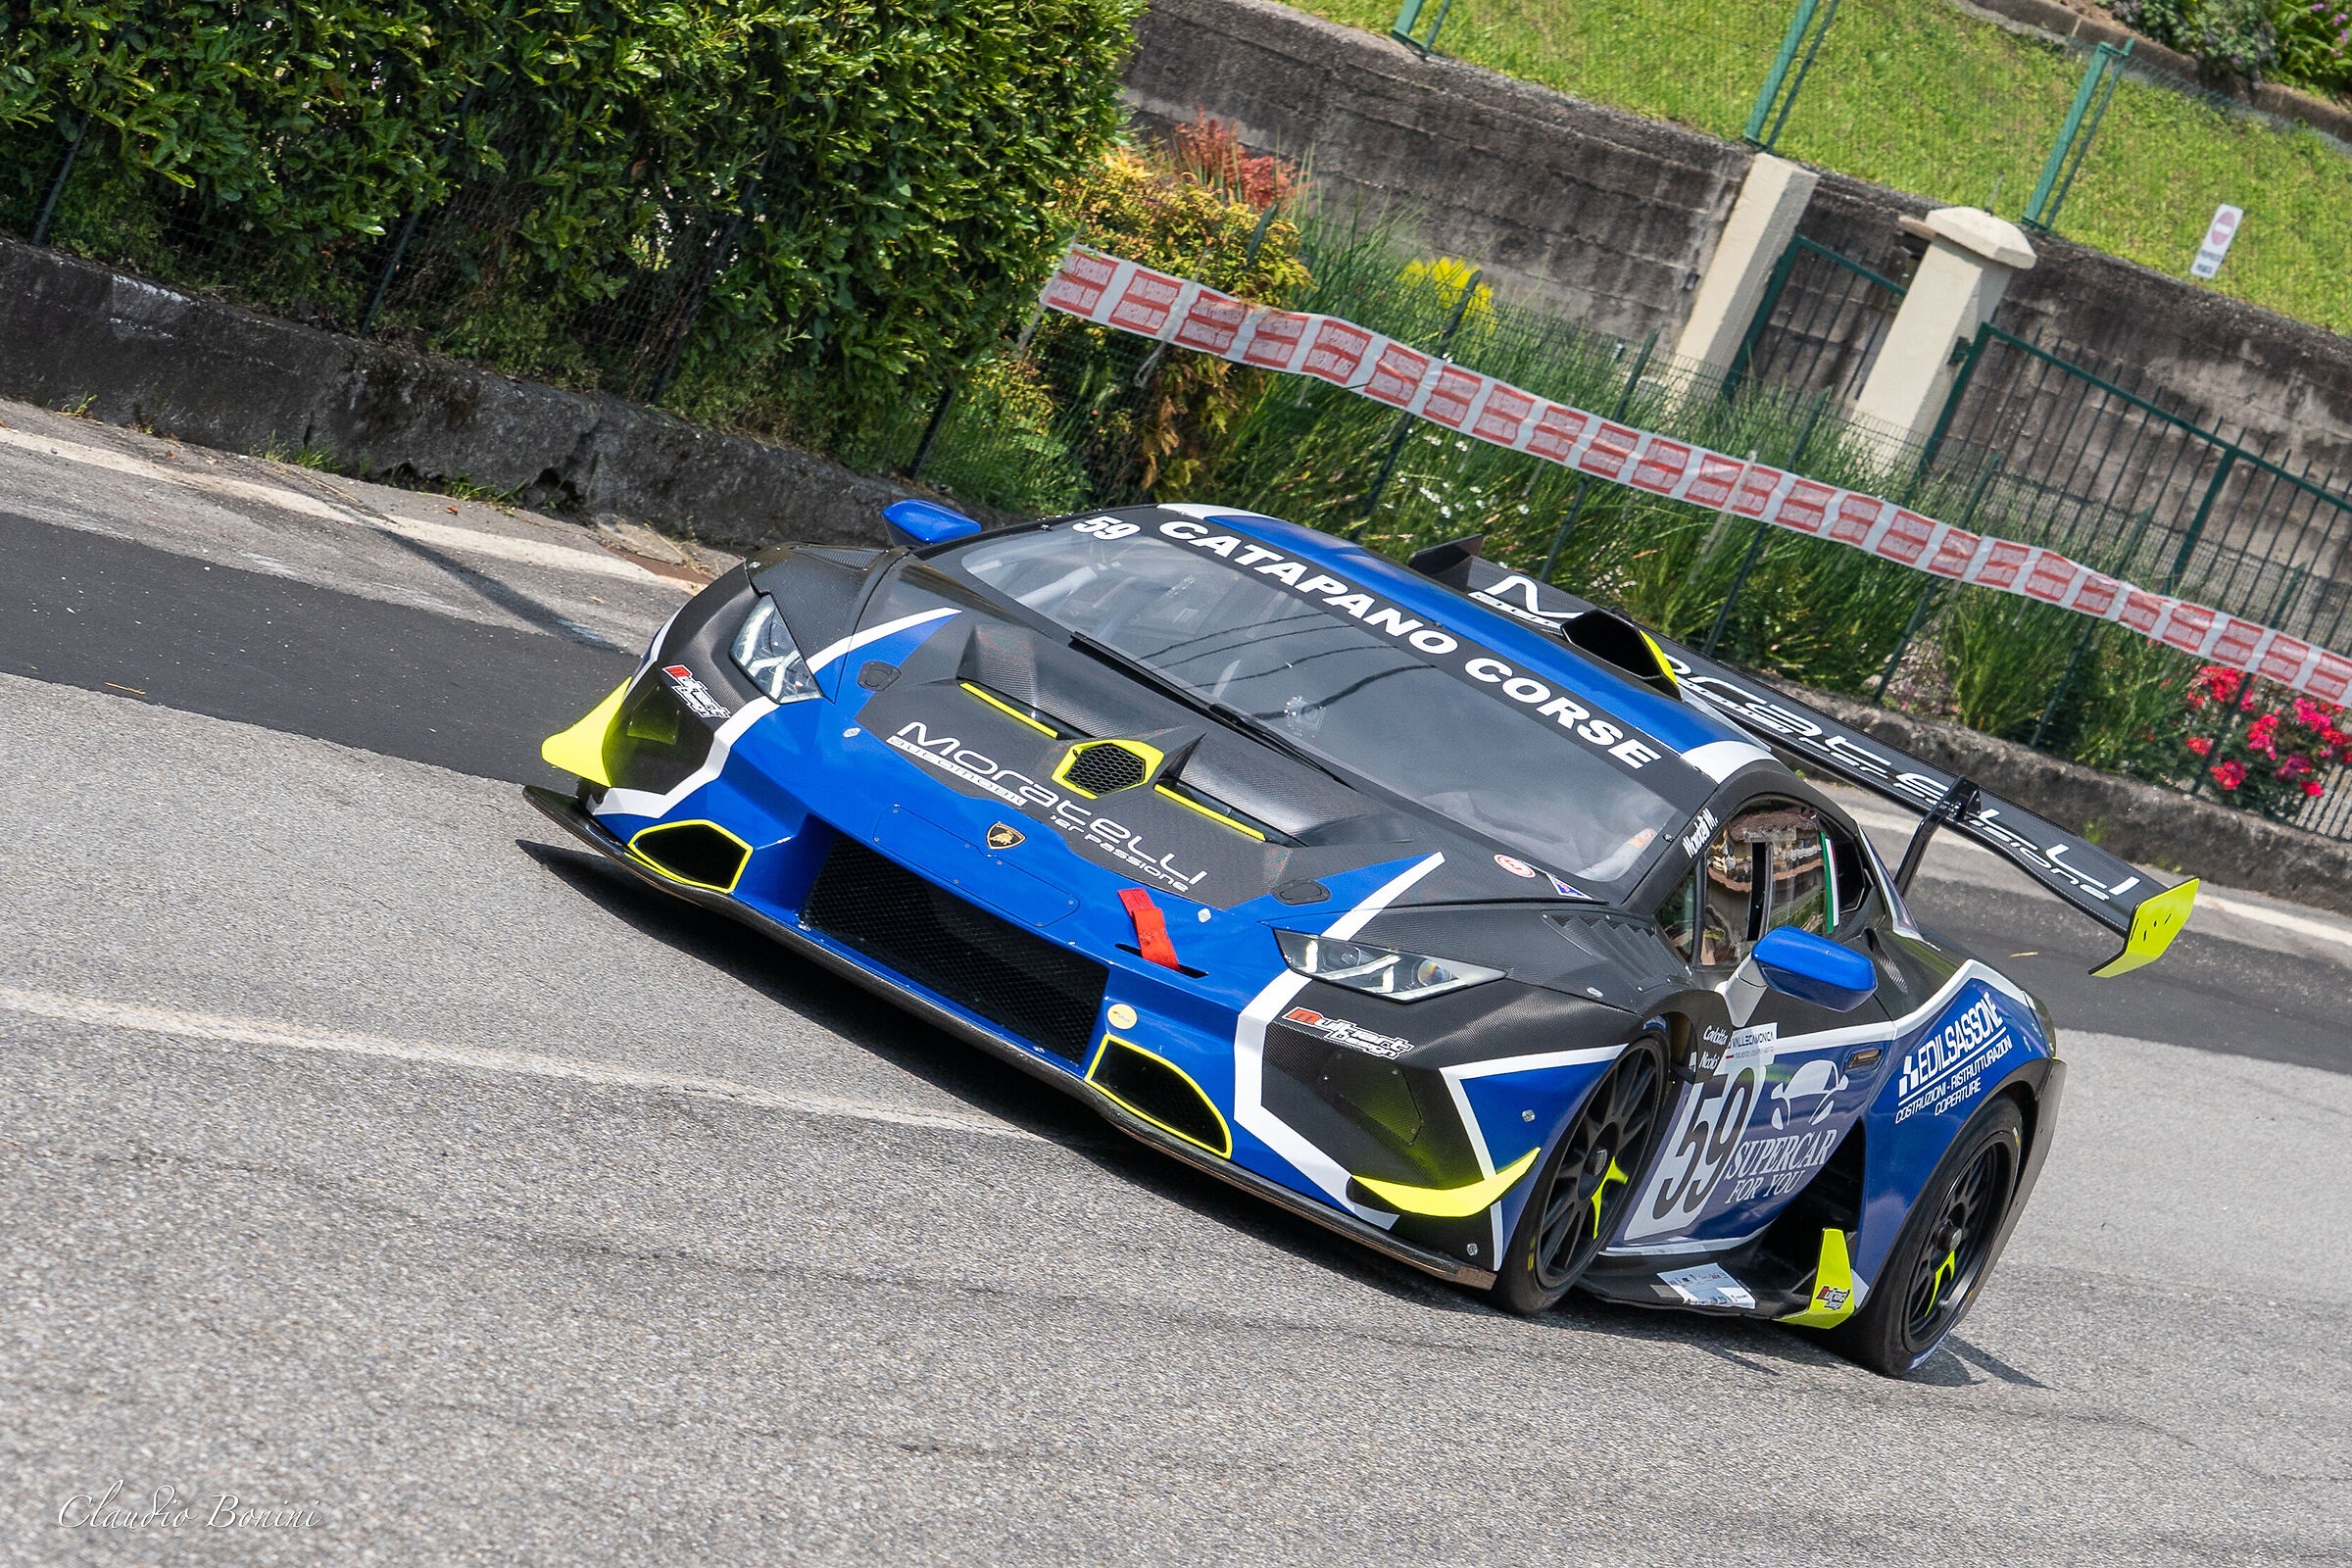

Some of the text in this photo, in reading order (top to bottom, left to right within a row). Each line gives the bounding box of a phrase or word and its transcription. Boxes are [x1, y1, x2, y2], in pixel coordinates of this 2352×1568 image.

[1072, 515, 1141, 540] 59
[1158, 520, 1459, 655] CATAPANO
[1464, 658, 1662, 769] CORSE
[1918, 991, 2003, 1085] EDILSASSONE
[1894, 1081, 1947, 1124] COSTRUZIONI
[1934, 1076, 1982, 1116] COPERTURE
[1652, 1066, 1755, 1220] 59
[1724, 1129, 1838, 1181] SUPERCAR
[1725, 1170, 1806, 1204] FOR YOU
